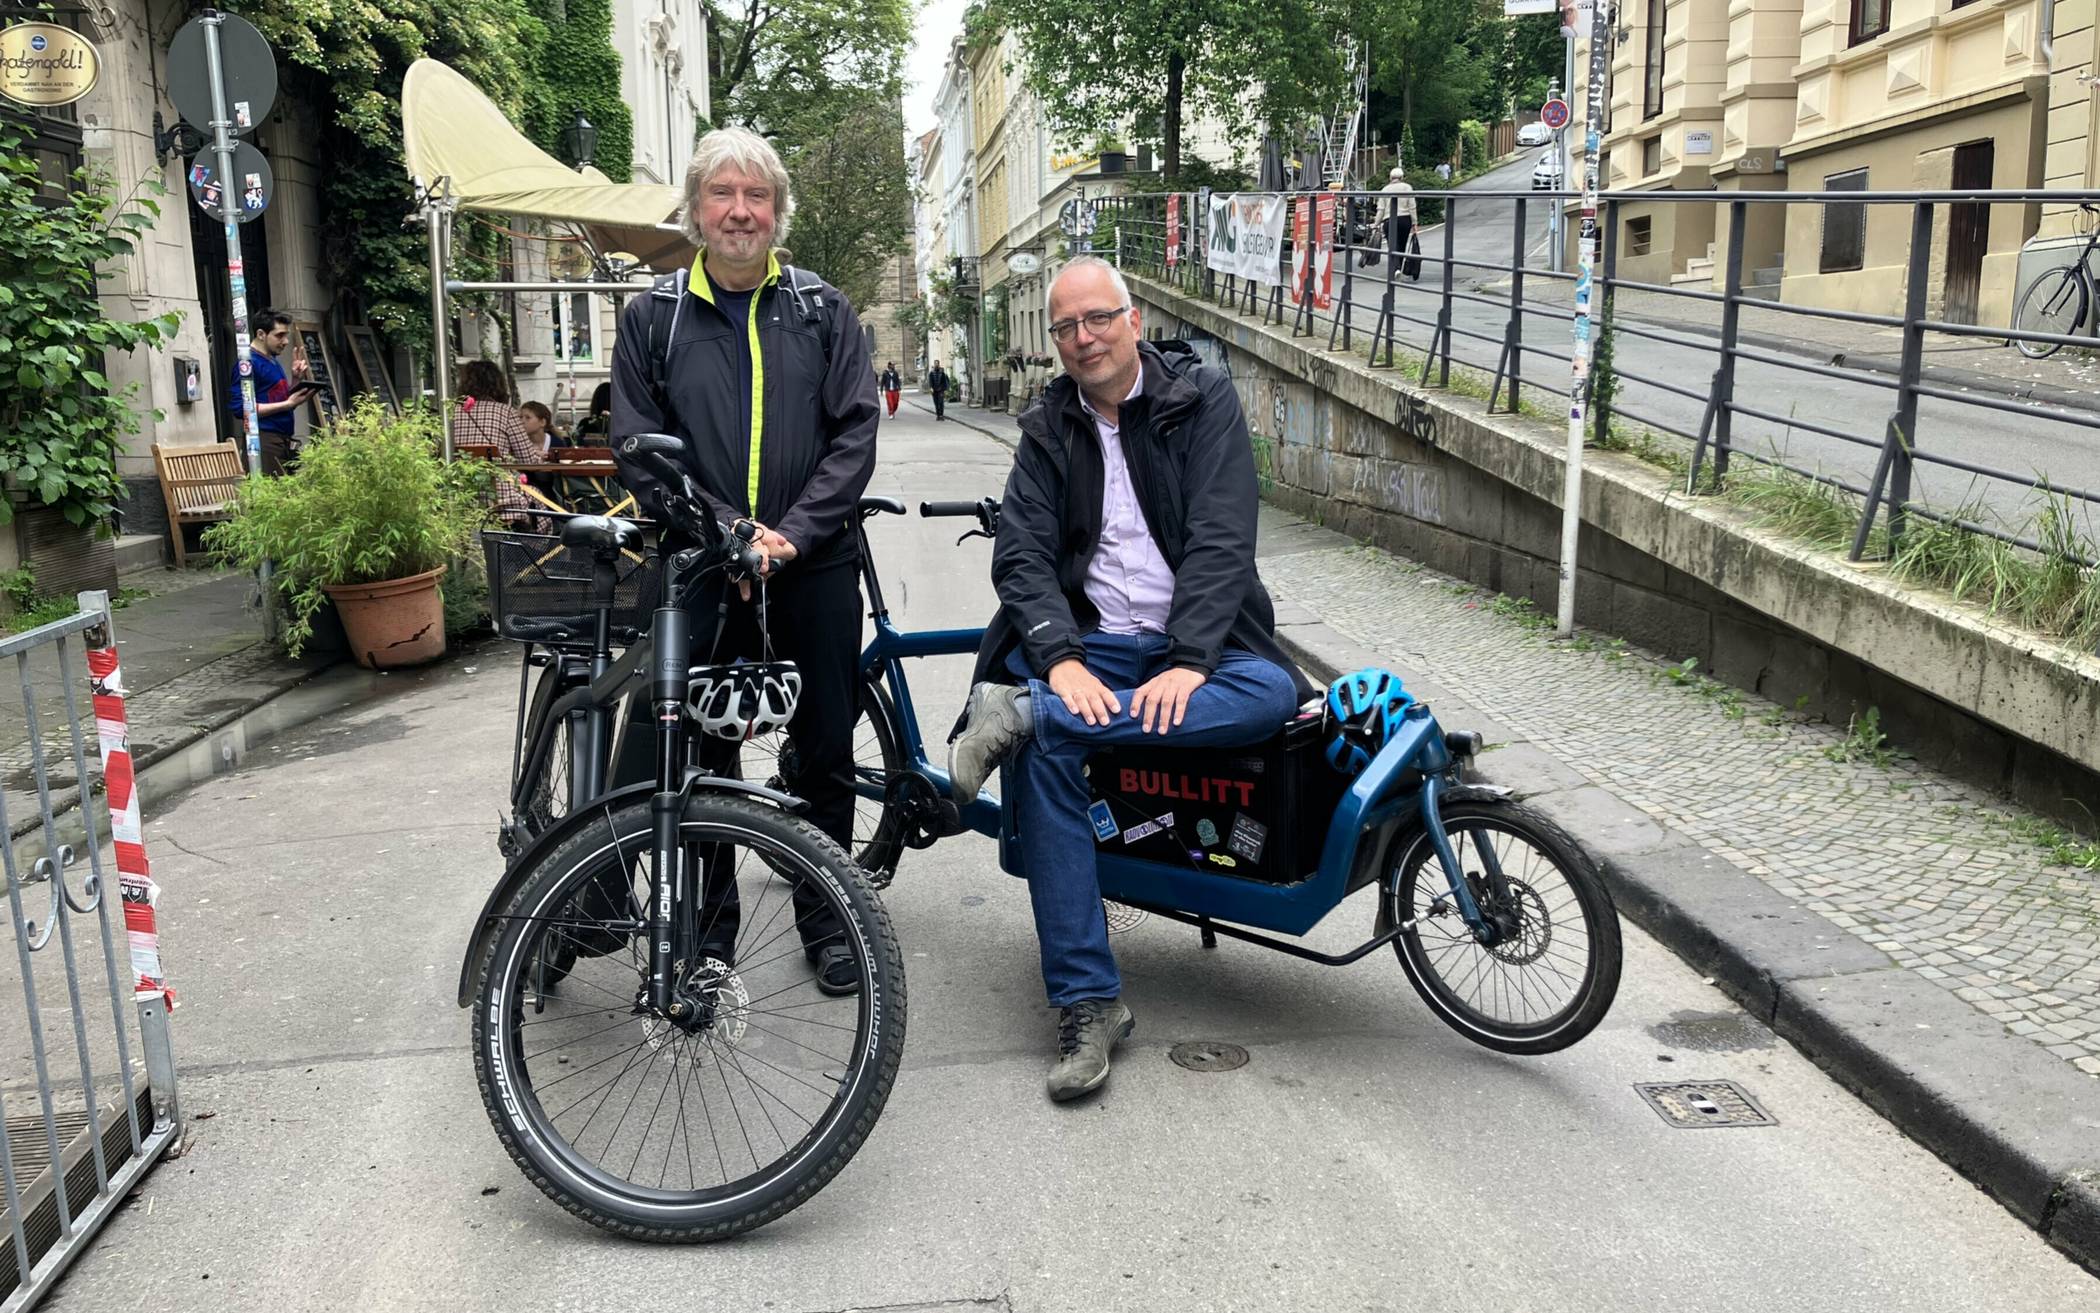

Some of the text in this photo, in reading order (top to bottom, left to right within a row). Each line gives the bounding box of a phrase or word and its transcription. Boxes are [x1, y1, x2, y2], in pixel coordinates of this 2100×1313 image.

[1738, 156, 1763, 171] CLS
[1120, 767, 1255, 807] BULLITT
[870, 979, 881, 1060] JOHNNY
[489, 987, 528, 1132] SCHWALBE
